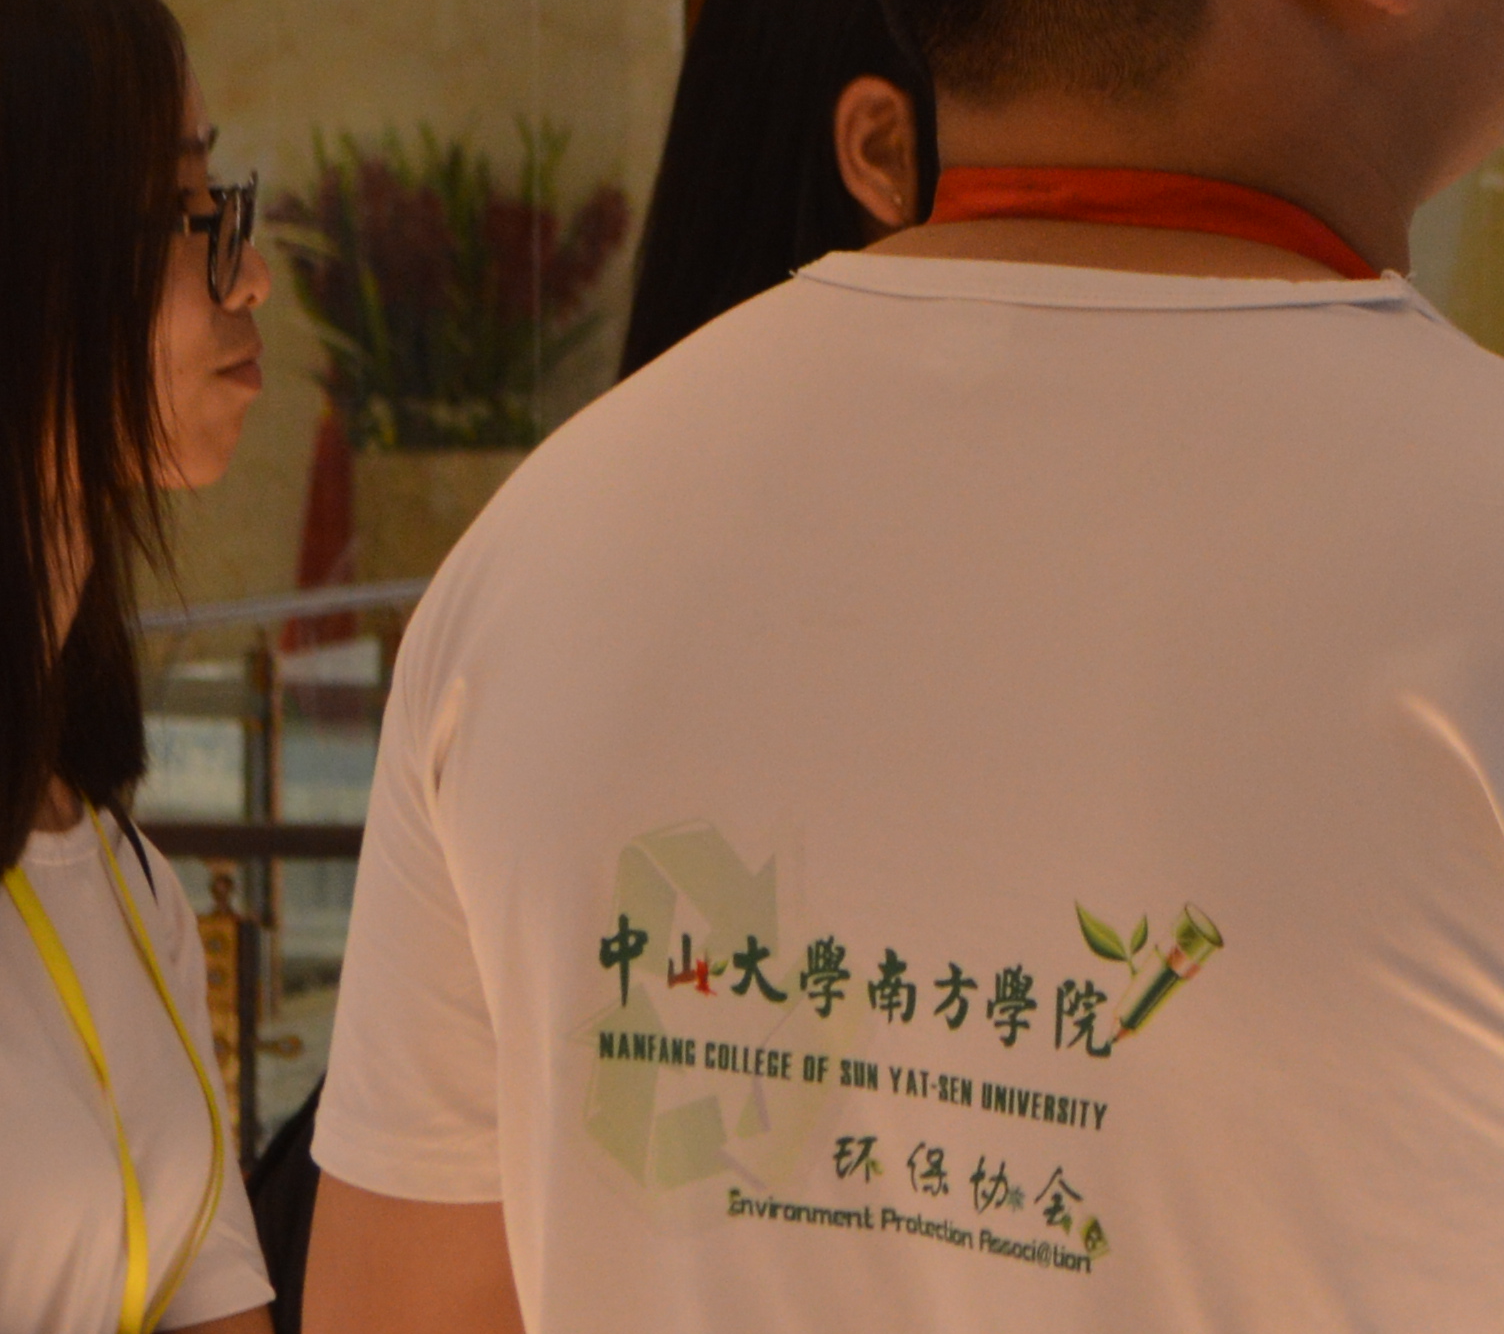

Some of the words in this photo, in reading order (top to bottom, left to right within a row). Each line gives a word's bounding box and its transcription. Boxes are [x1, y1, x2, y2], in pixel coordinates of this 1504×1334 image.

[599, 1031, 696, 1066] NANFANG
[705, 1041, 793, 1080] COLLEGE
[803, 1054, 829, 1084] OF
[840, 1058, 879, 1091] SUN
[889, 1066, 973, 1107] YAT-SEN
[982, 1081, 1108, 1131] UNIVERSITY
[728, 1187, 874, 1230] Environment
[881, 1207, 974, 1251] Protection
